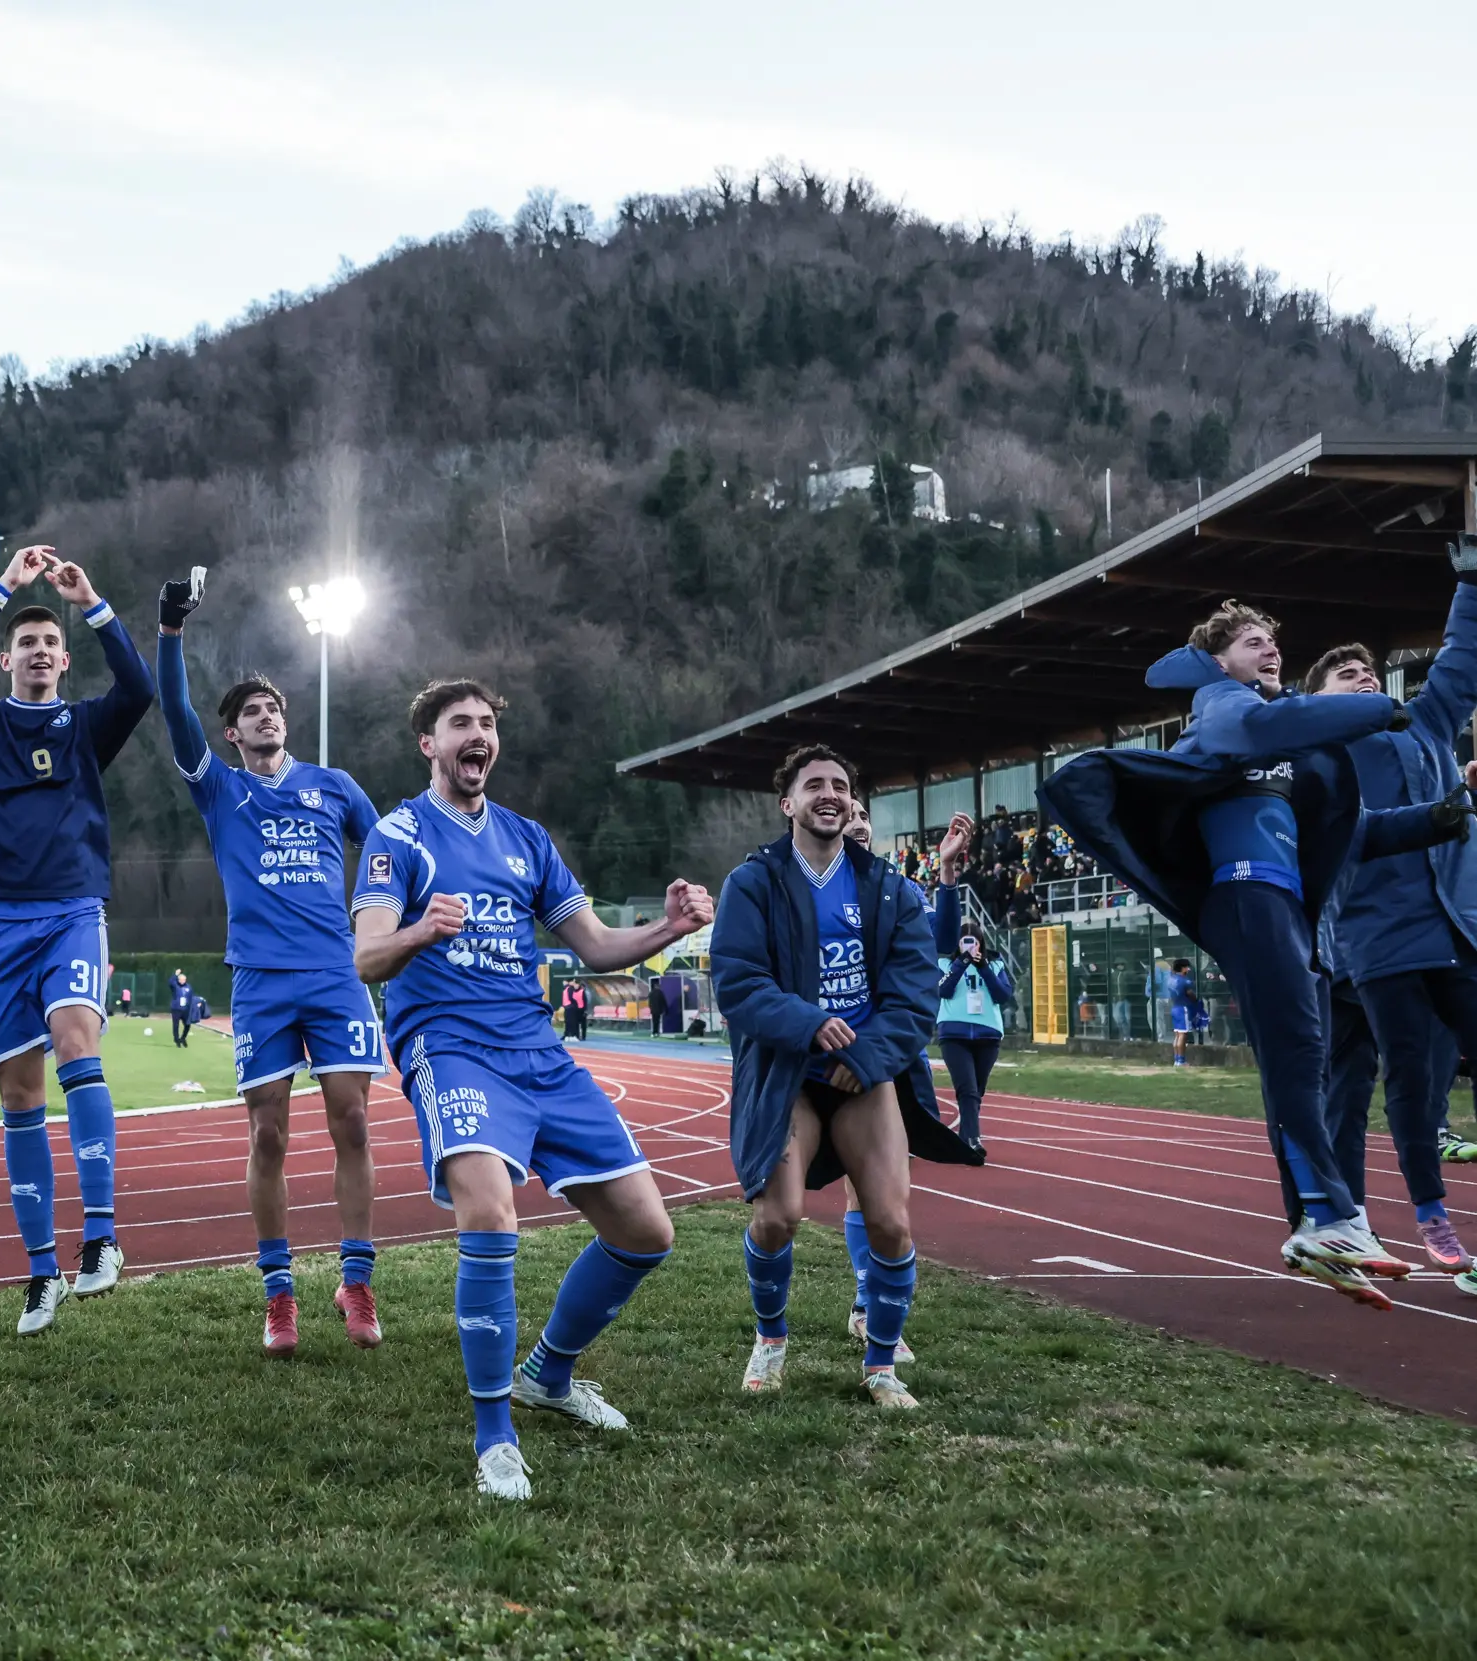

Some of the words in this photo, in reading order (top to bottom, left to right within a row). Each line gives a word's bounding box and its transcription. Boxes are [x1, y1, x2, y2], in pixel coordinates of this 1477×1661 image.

[32, 748, 53, 780] 9
[260, 817, 317, 839] a2a
[279, 839, 318, 848] COMPANY
[372, 856, 388, 872] C
[283, 871, 328, 884] Marsh
[460, 924, 474, 932] IFE
[476, 924, 514, 933] COMPANY
[479, 953, 525, 977] Marsh
[235, 1032, 253, 1047] ARDA
[347, 1020, 379, 1058] 37
[437, 1087, 488, 1105] GARDA
[442, 1101, 490, 1118] STUBE
